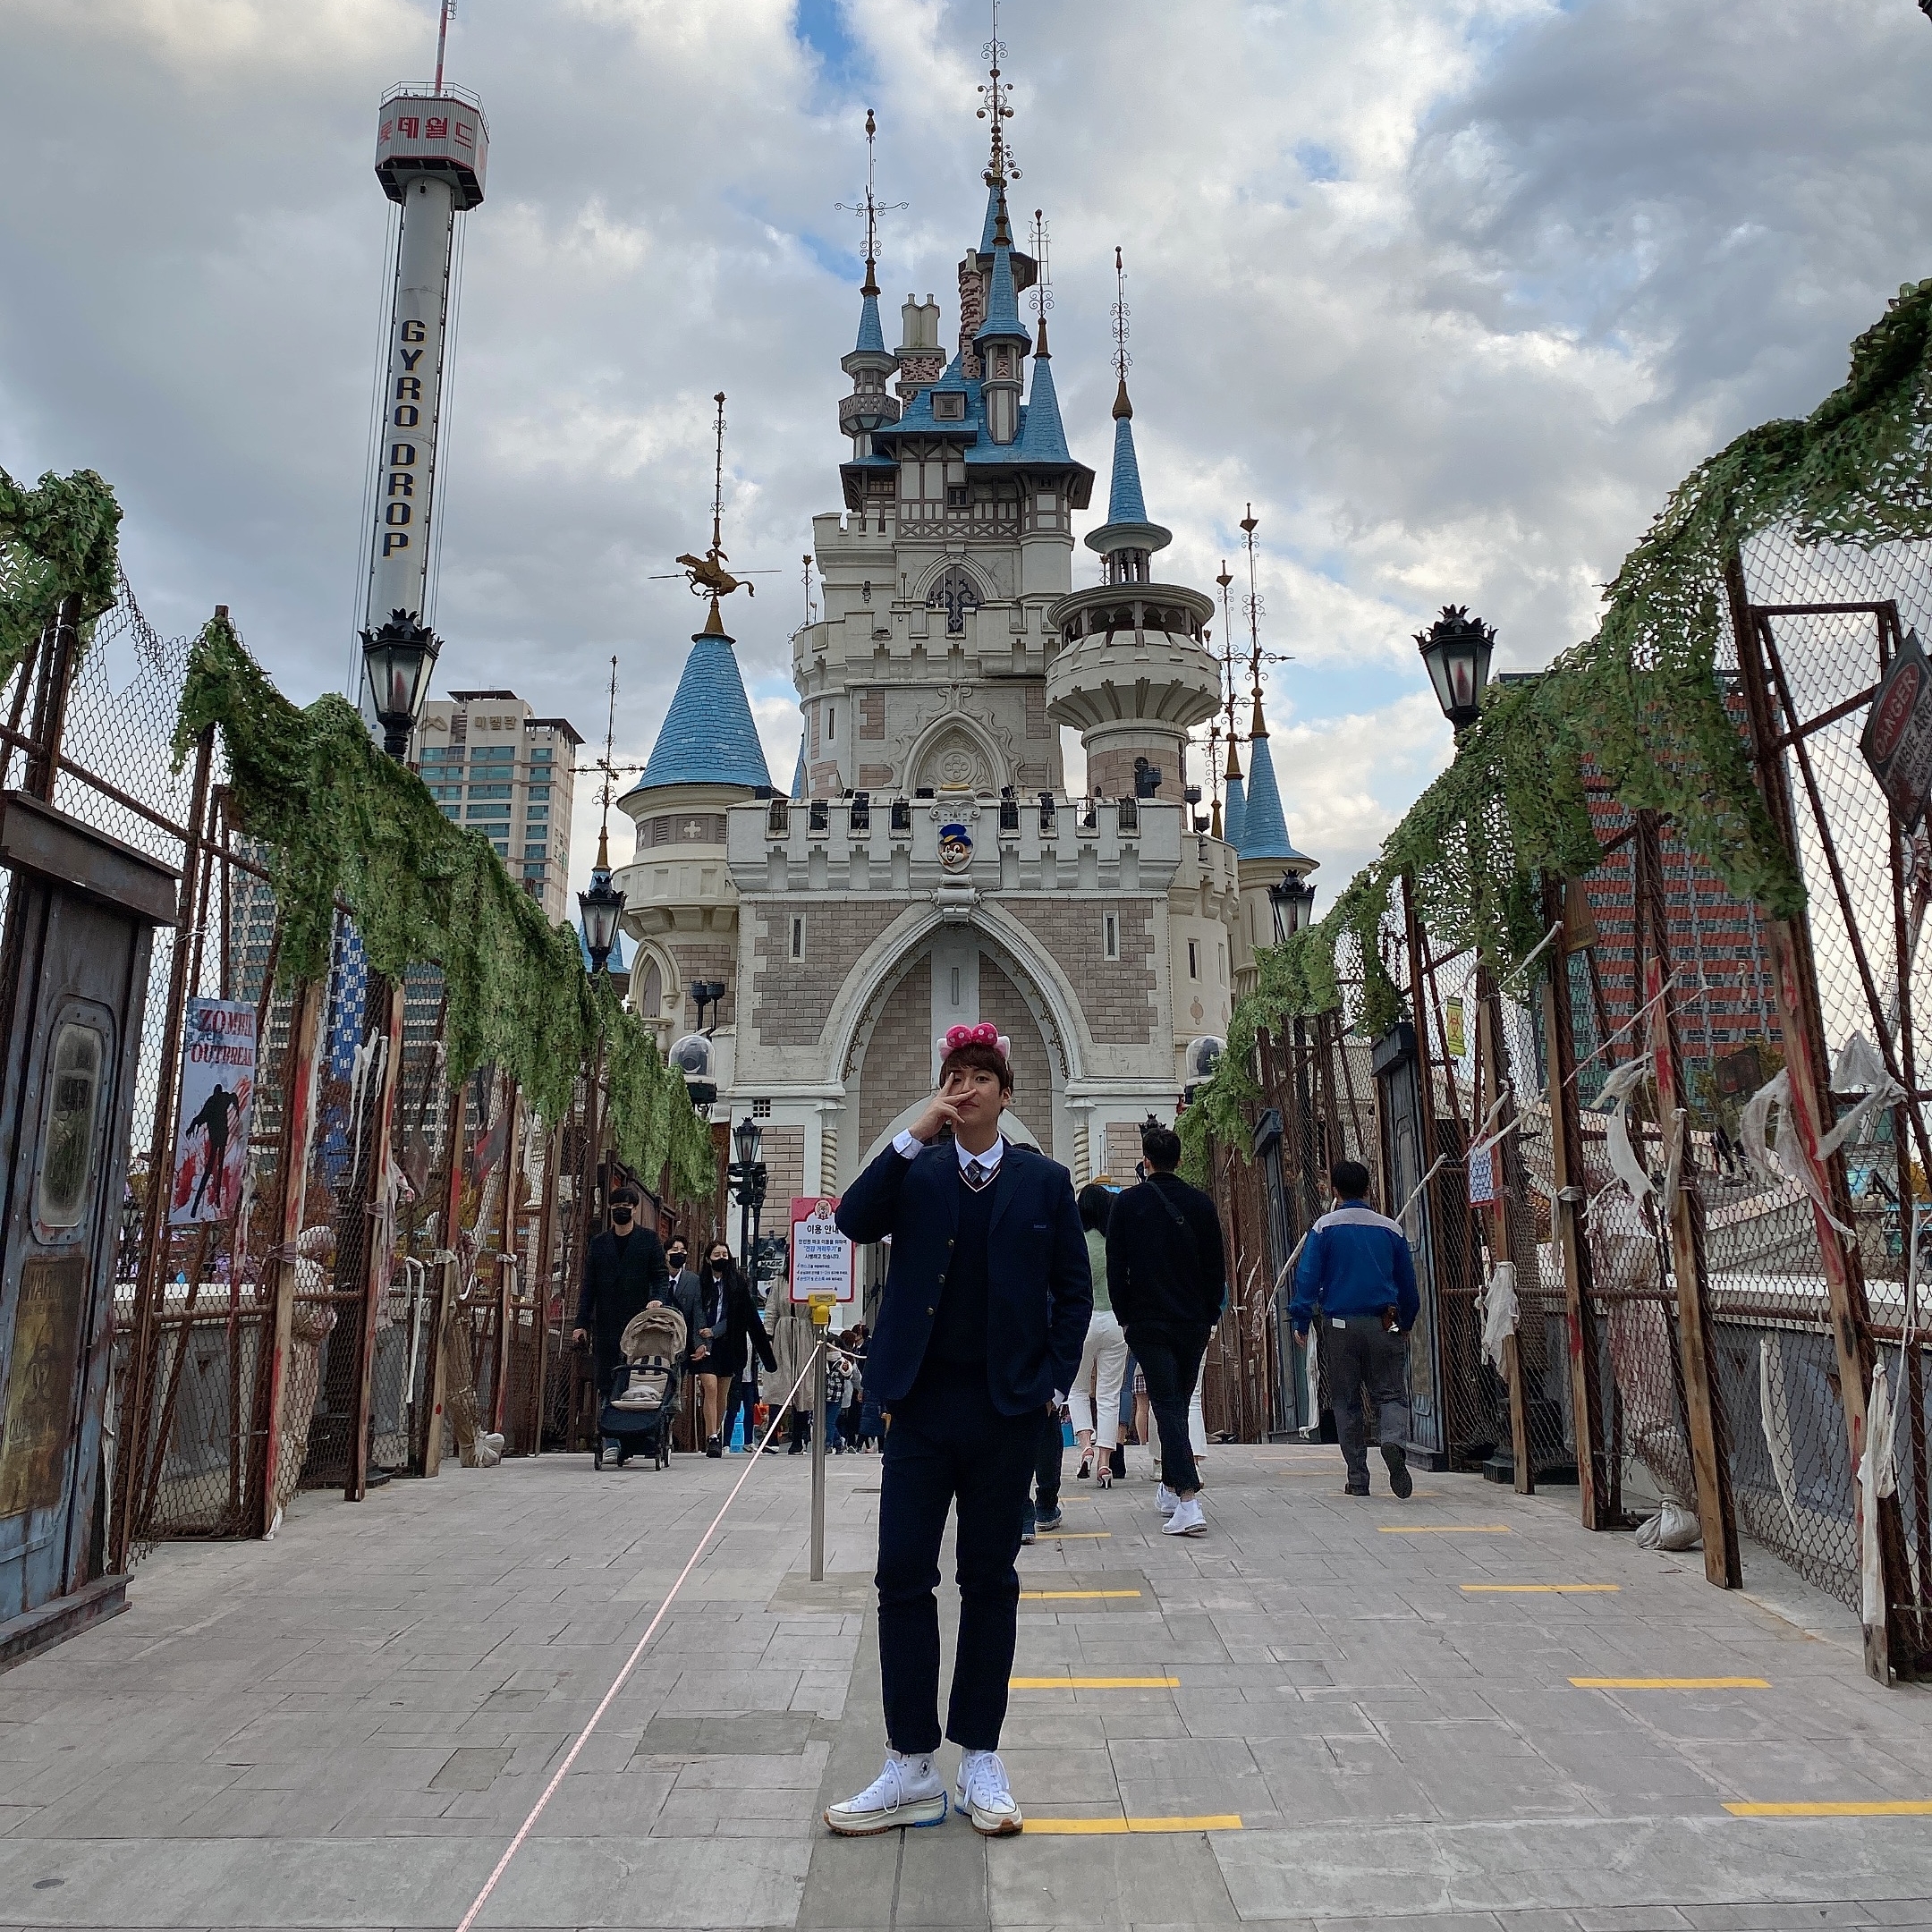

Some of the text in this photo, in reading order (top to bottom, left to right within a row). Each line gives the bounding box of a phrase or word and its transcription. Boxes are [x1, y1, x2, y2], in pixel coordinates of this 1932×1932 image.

[379, 117, 470, 148] 롯데월드
[383, 319, 427, 559] GYRO DROP
[1875, 670, 1917, 758] DANGER
[198, 1008, 253, 1037] ZOMBIE
[191, 1043, 253, 1066] OUTBREAK
[807, 1224, 839, 1234] 이용 안내
